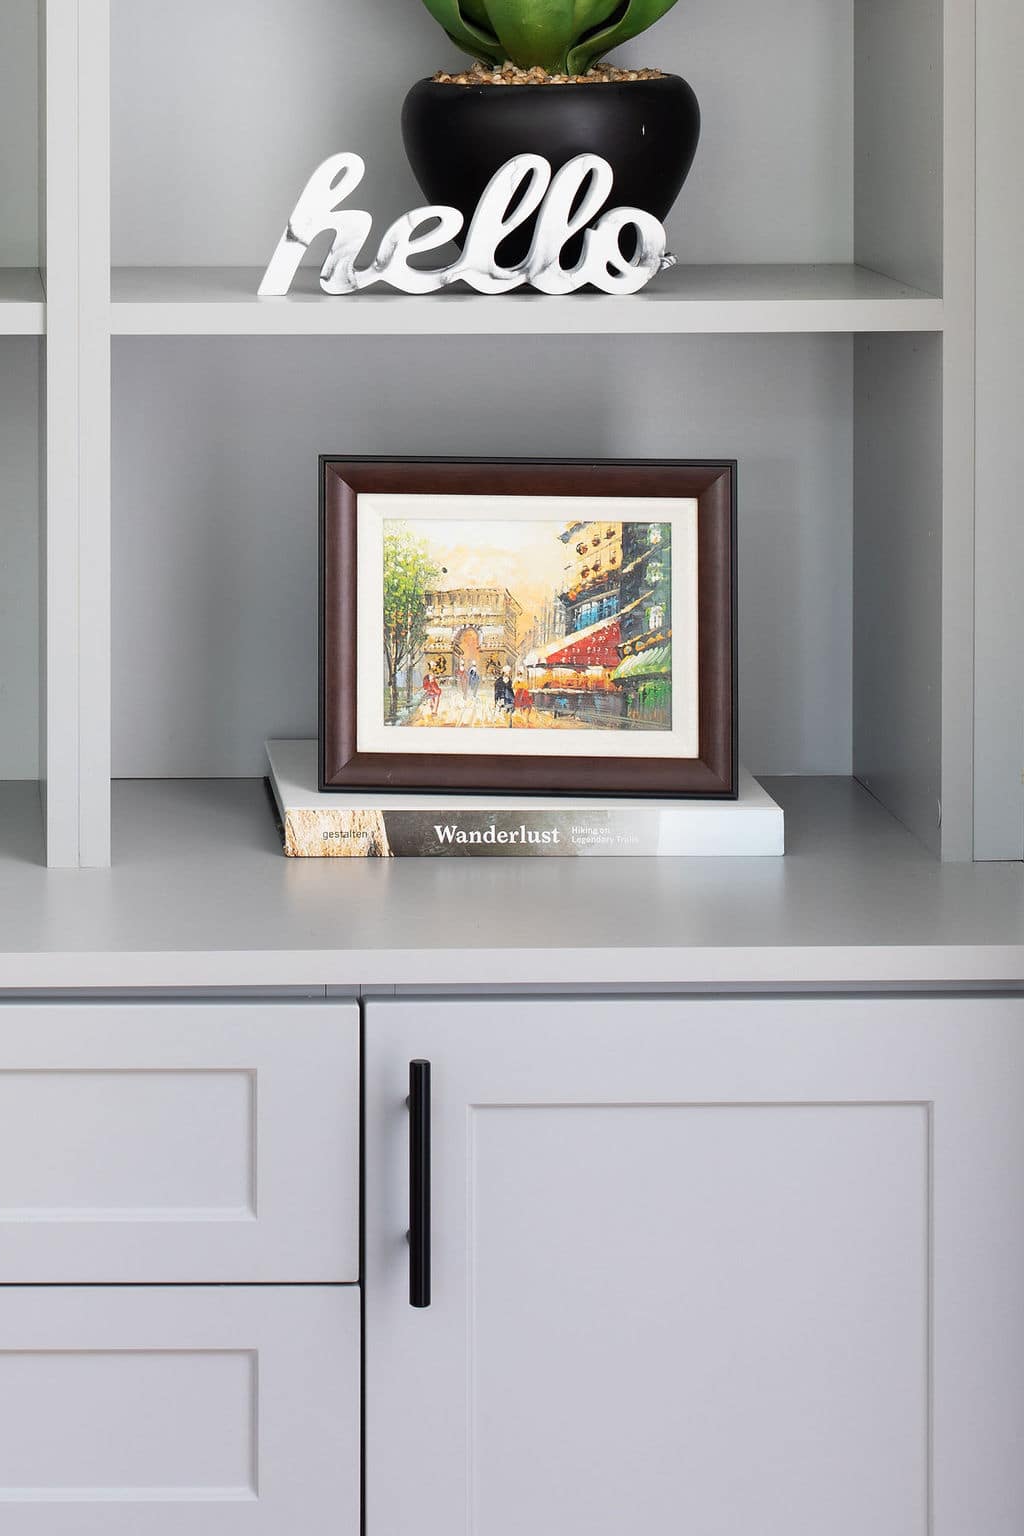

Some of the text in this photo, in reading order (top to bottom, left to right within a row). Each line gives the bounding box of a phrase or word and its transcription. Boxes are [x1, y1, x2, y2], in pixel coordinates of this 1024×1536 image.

[257, 152, 667, 296] hello
[322, 830, 368, 841] gestalten
[434, 825, 561, 844] Wanderlust
[571, 826, 599, 835] Hiking
